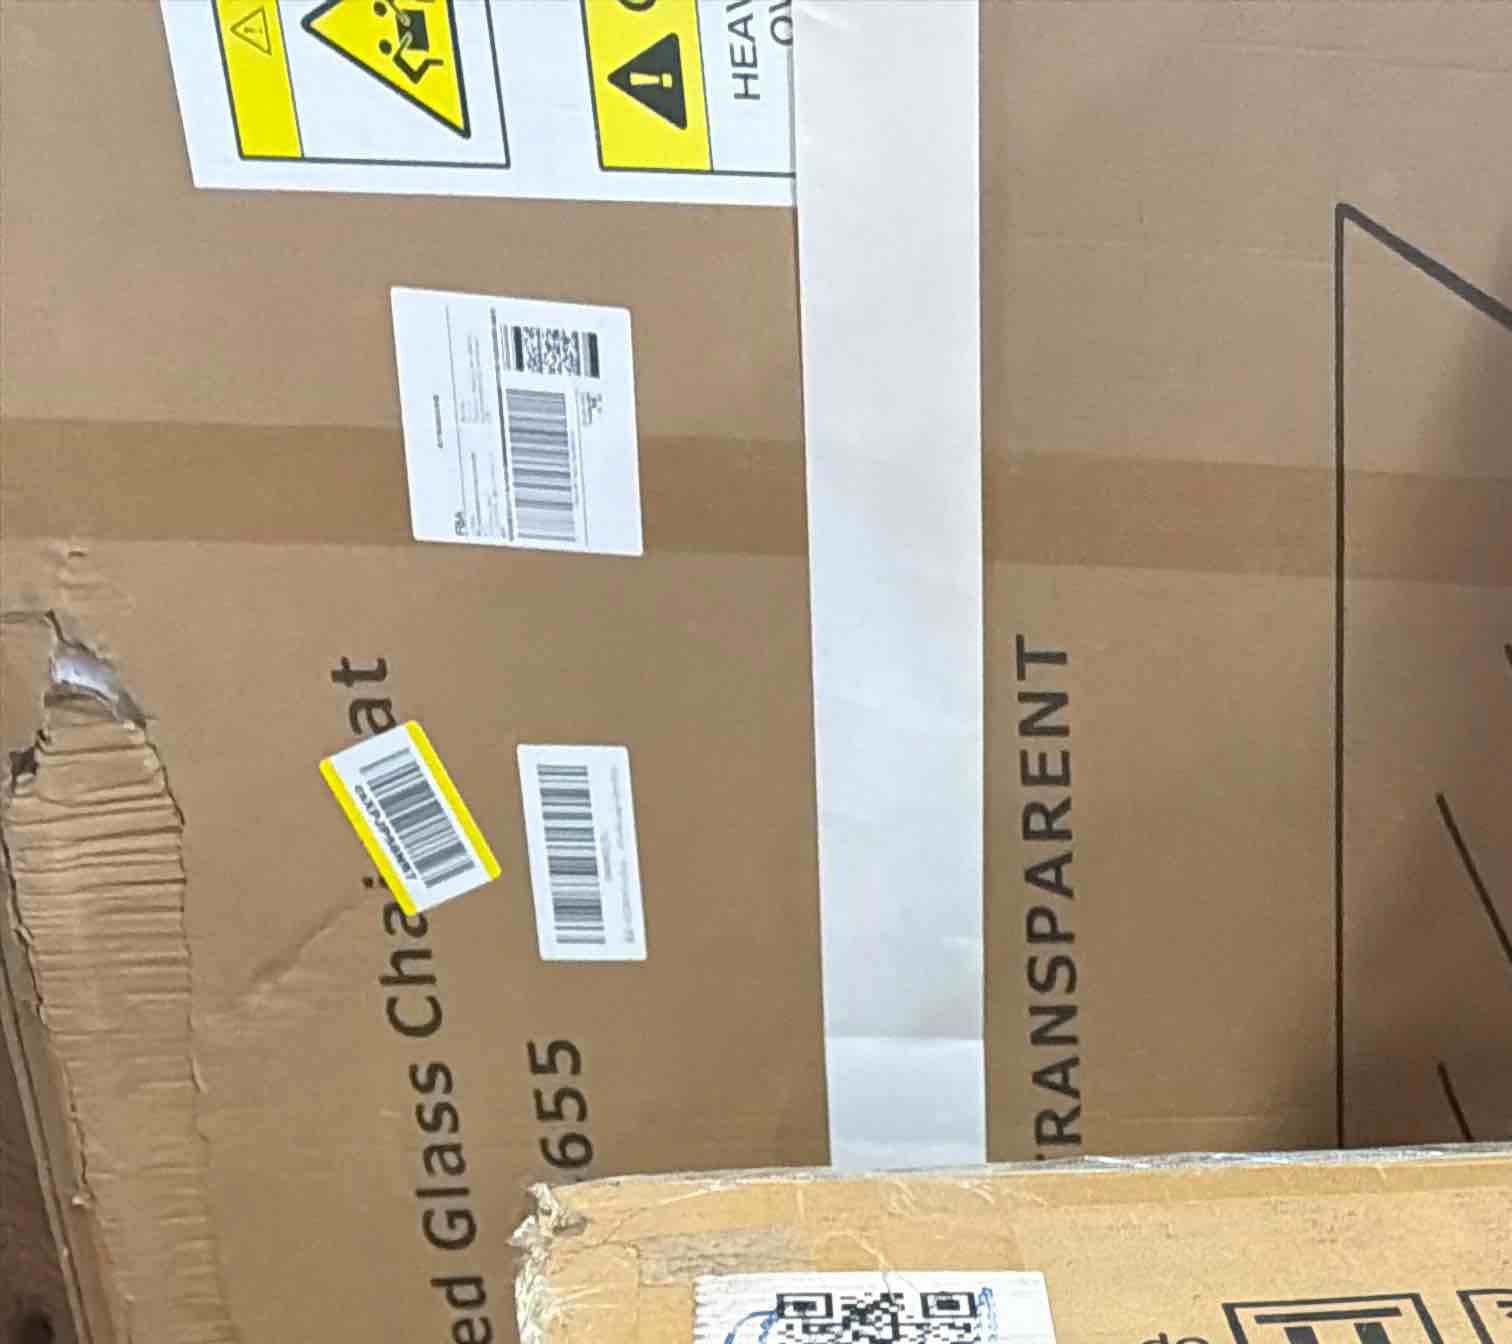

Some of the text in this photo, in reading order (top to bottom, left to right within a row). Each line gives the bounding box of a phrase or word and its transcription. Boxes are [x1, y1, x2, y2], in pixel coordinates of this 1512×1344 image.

[363, 875, 443, 1038] Cha
[1015, 633, 1084, 1161] RANSPARENT
[409, 1060, 477, 1250] Glass
[526, 1038, 594, 1174] 655
